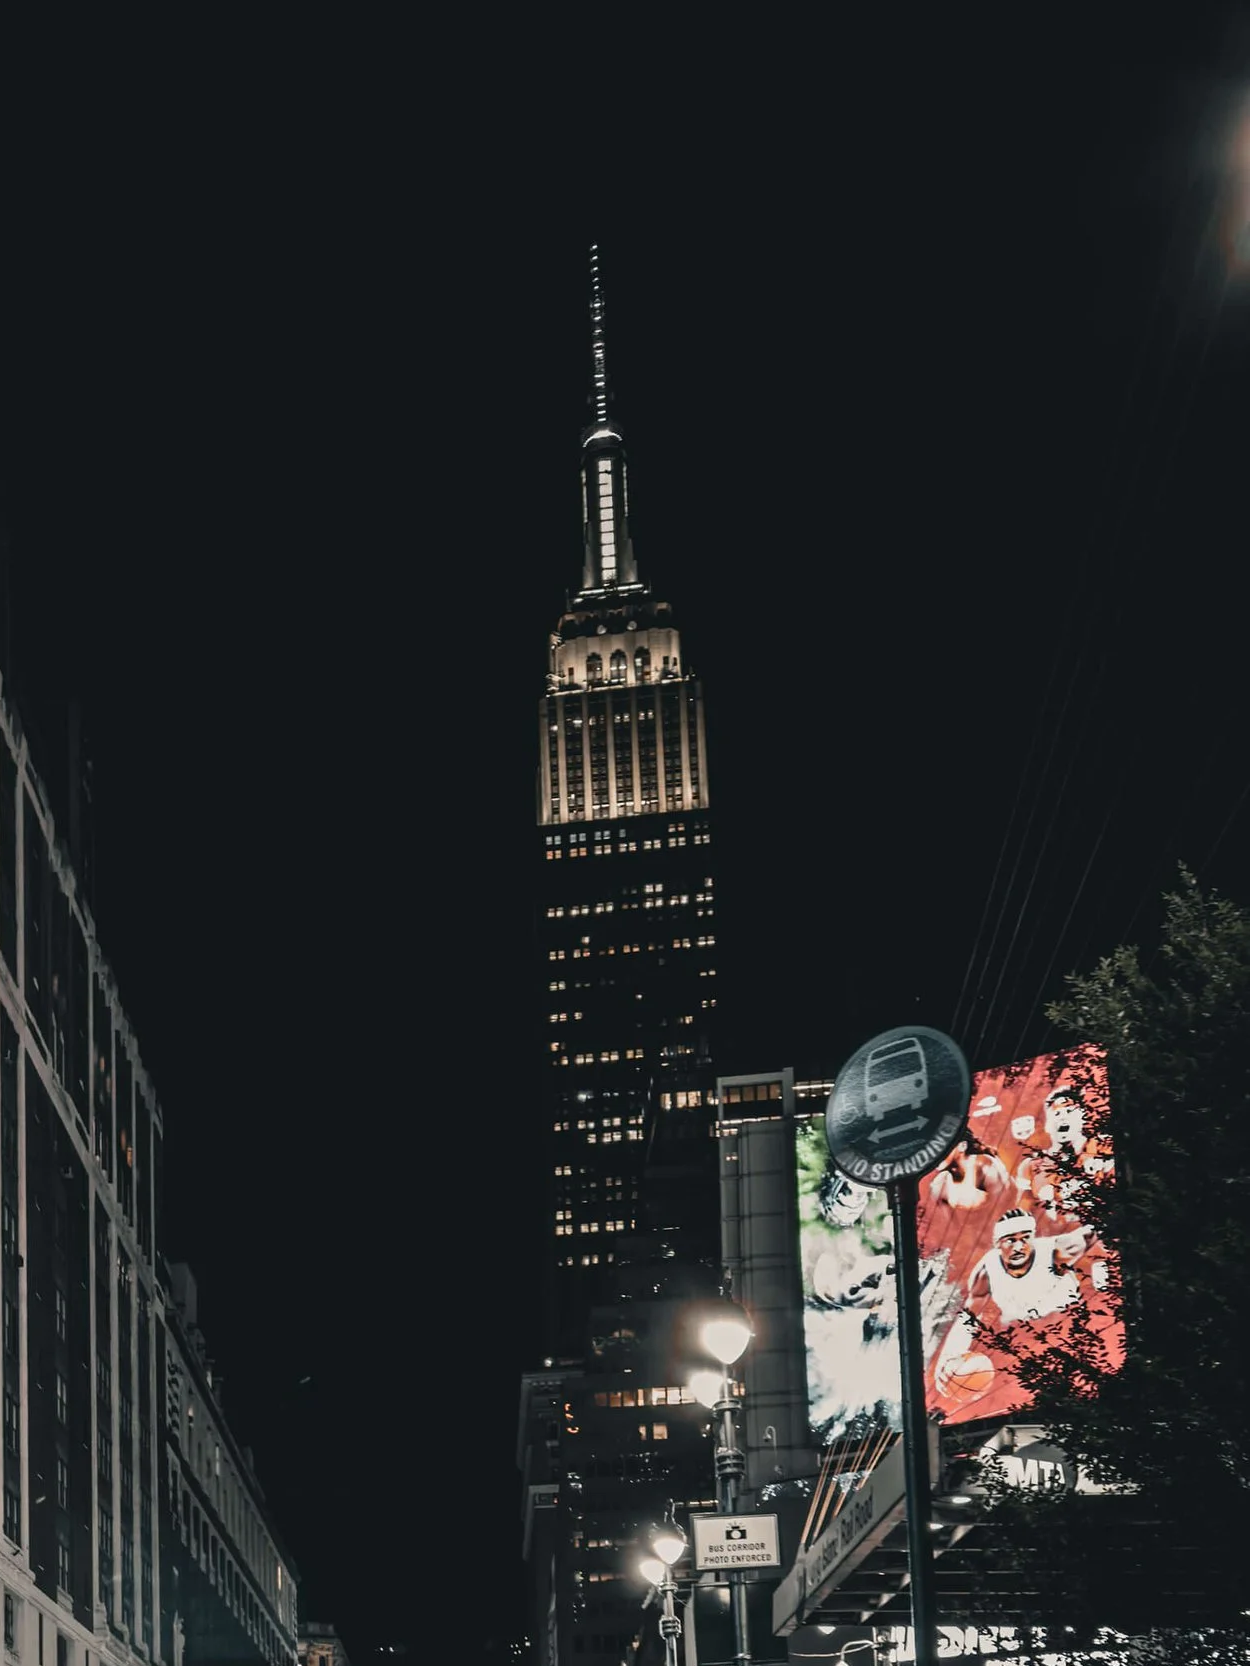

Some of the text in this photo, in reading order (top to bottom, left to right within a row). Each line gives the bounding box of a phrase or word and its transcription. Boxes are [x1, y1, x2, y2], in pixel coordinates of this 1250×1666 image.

[840, 1152, 868, 1176] NO
[870, 1114, 962, 1181] STANDING
[726, 1542, 766, 1552] CORRIDOR
[703, 1553, 771, 1564] PHOTO ENFORCED
